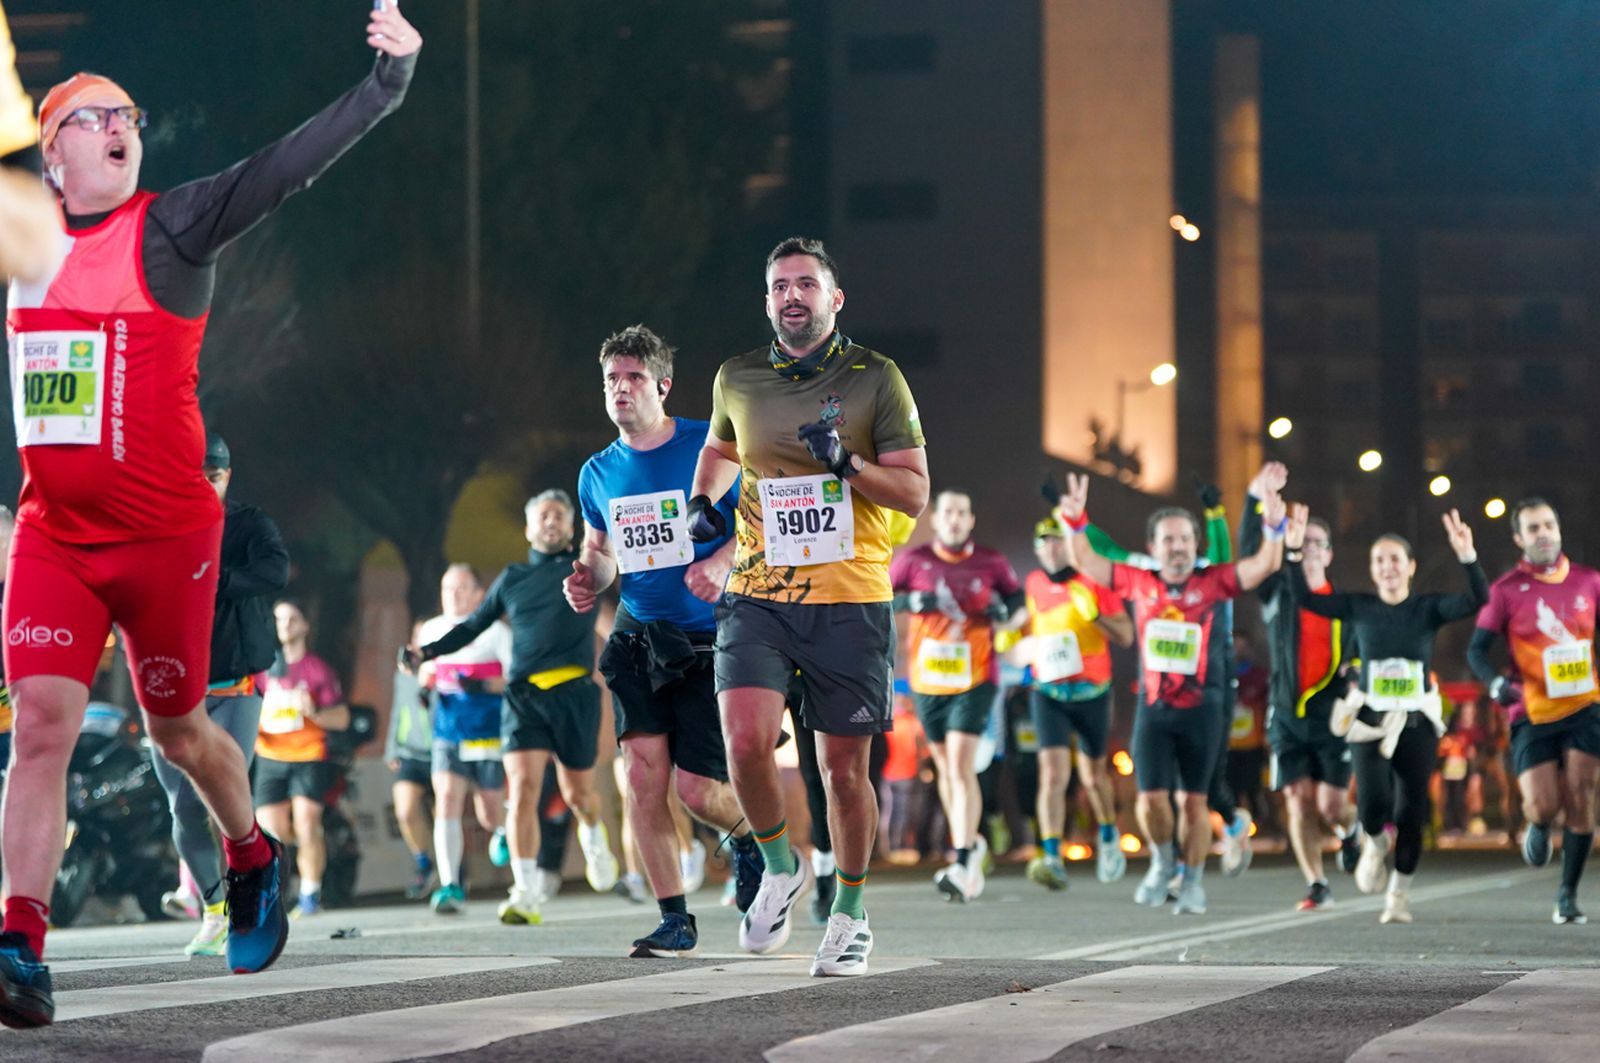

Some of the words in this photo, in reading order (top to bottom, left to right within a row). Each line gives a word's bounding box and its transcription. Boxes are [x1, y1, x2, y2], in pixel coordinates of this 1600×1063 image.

[24, 344, 45, 358] OCHE
[775, 487, 801, 498] NOCHE
[803, 486, 815, 496] DE
[784, 496, 816, 508] ANTÓN
[624, 505, 647, 516] NOCHE
[647, 504, 655, 513] DE
[631, 513, 656, 525] ANTÓN
[776, 506, 837, 536] 5902
[623, 521, 675, 549] 3335
